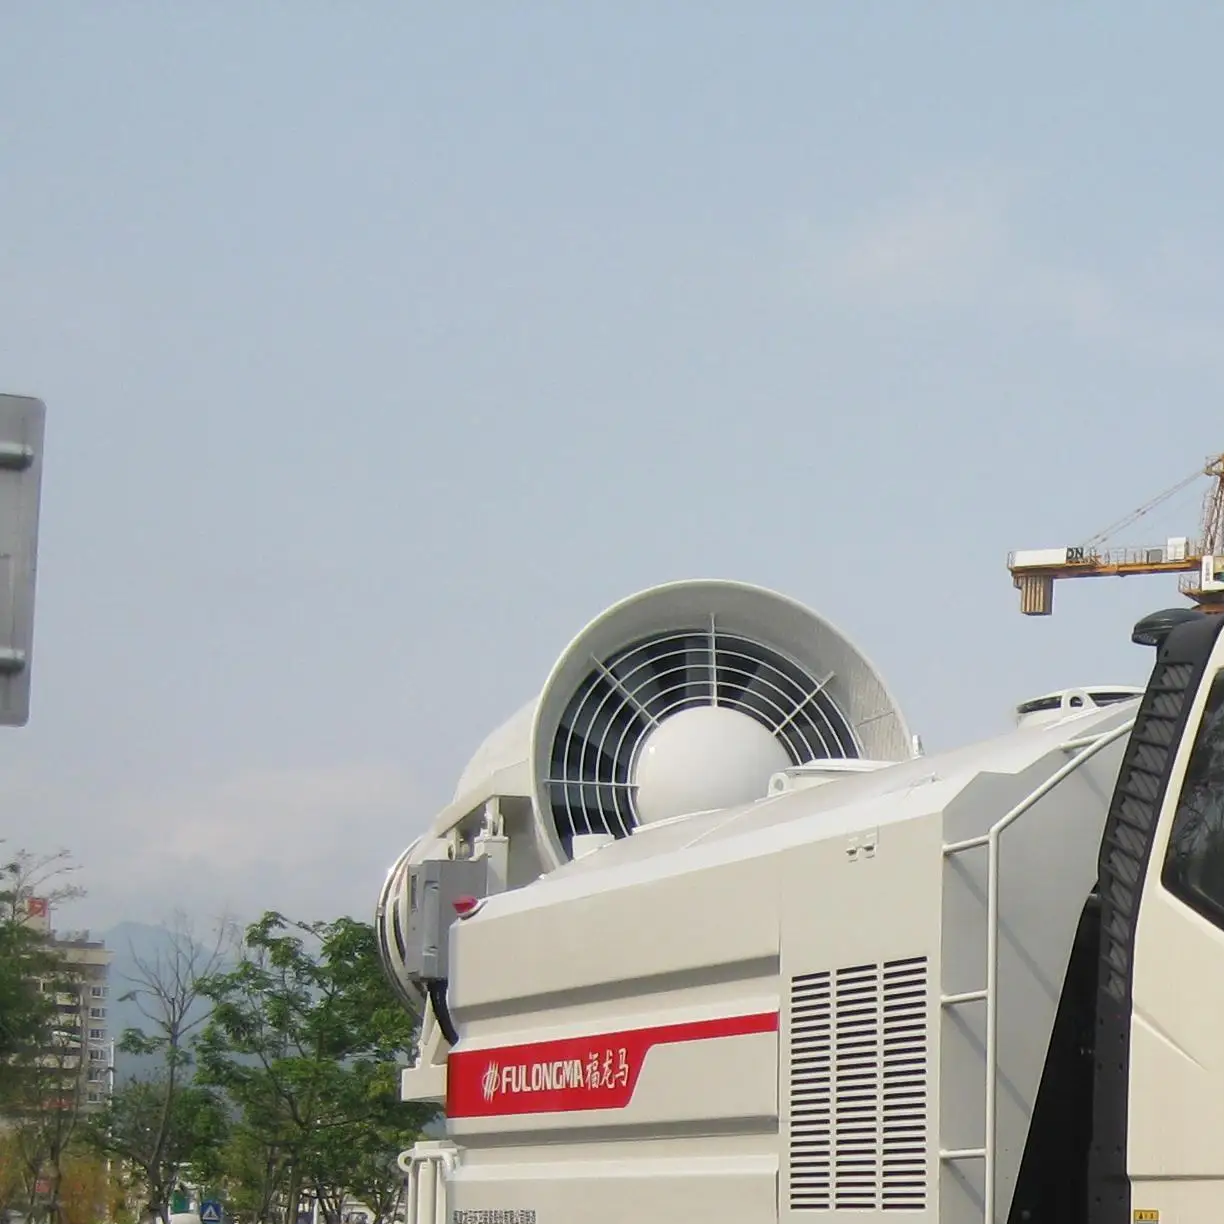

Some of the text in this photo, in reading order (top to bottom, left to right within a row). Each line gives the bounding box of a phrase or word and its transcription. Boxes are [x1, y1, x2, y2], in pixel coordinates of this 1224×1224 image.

[501, 1048, 629, 1094] FULONGMA 福龙马
